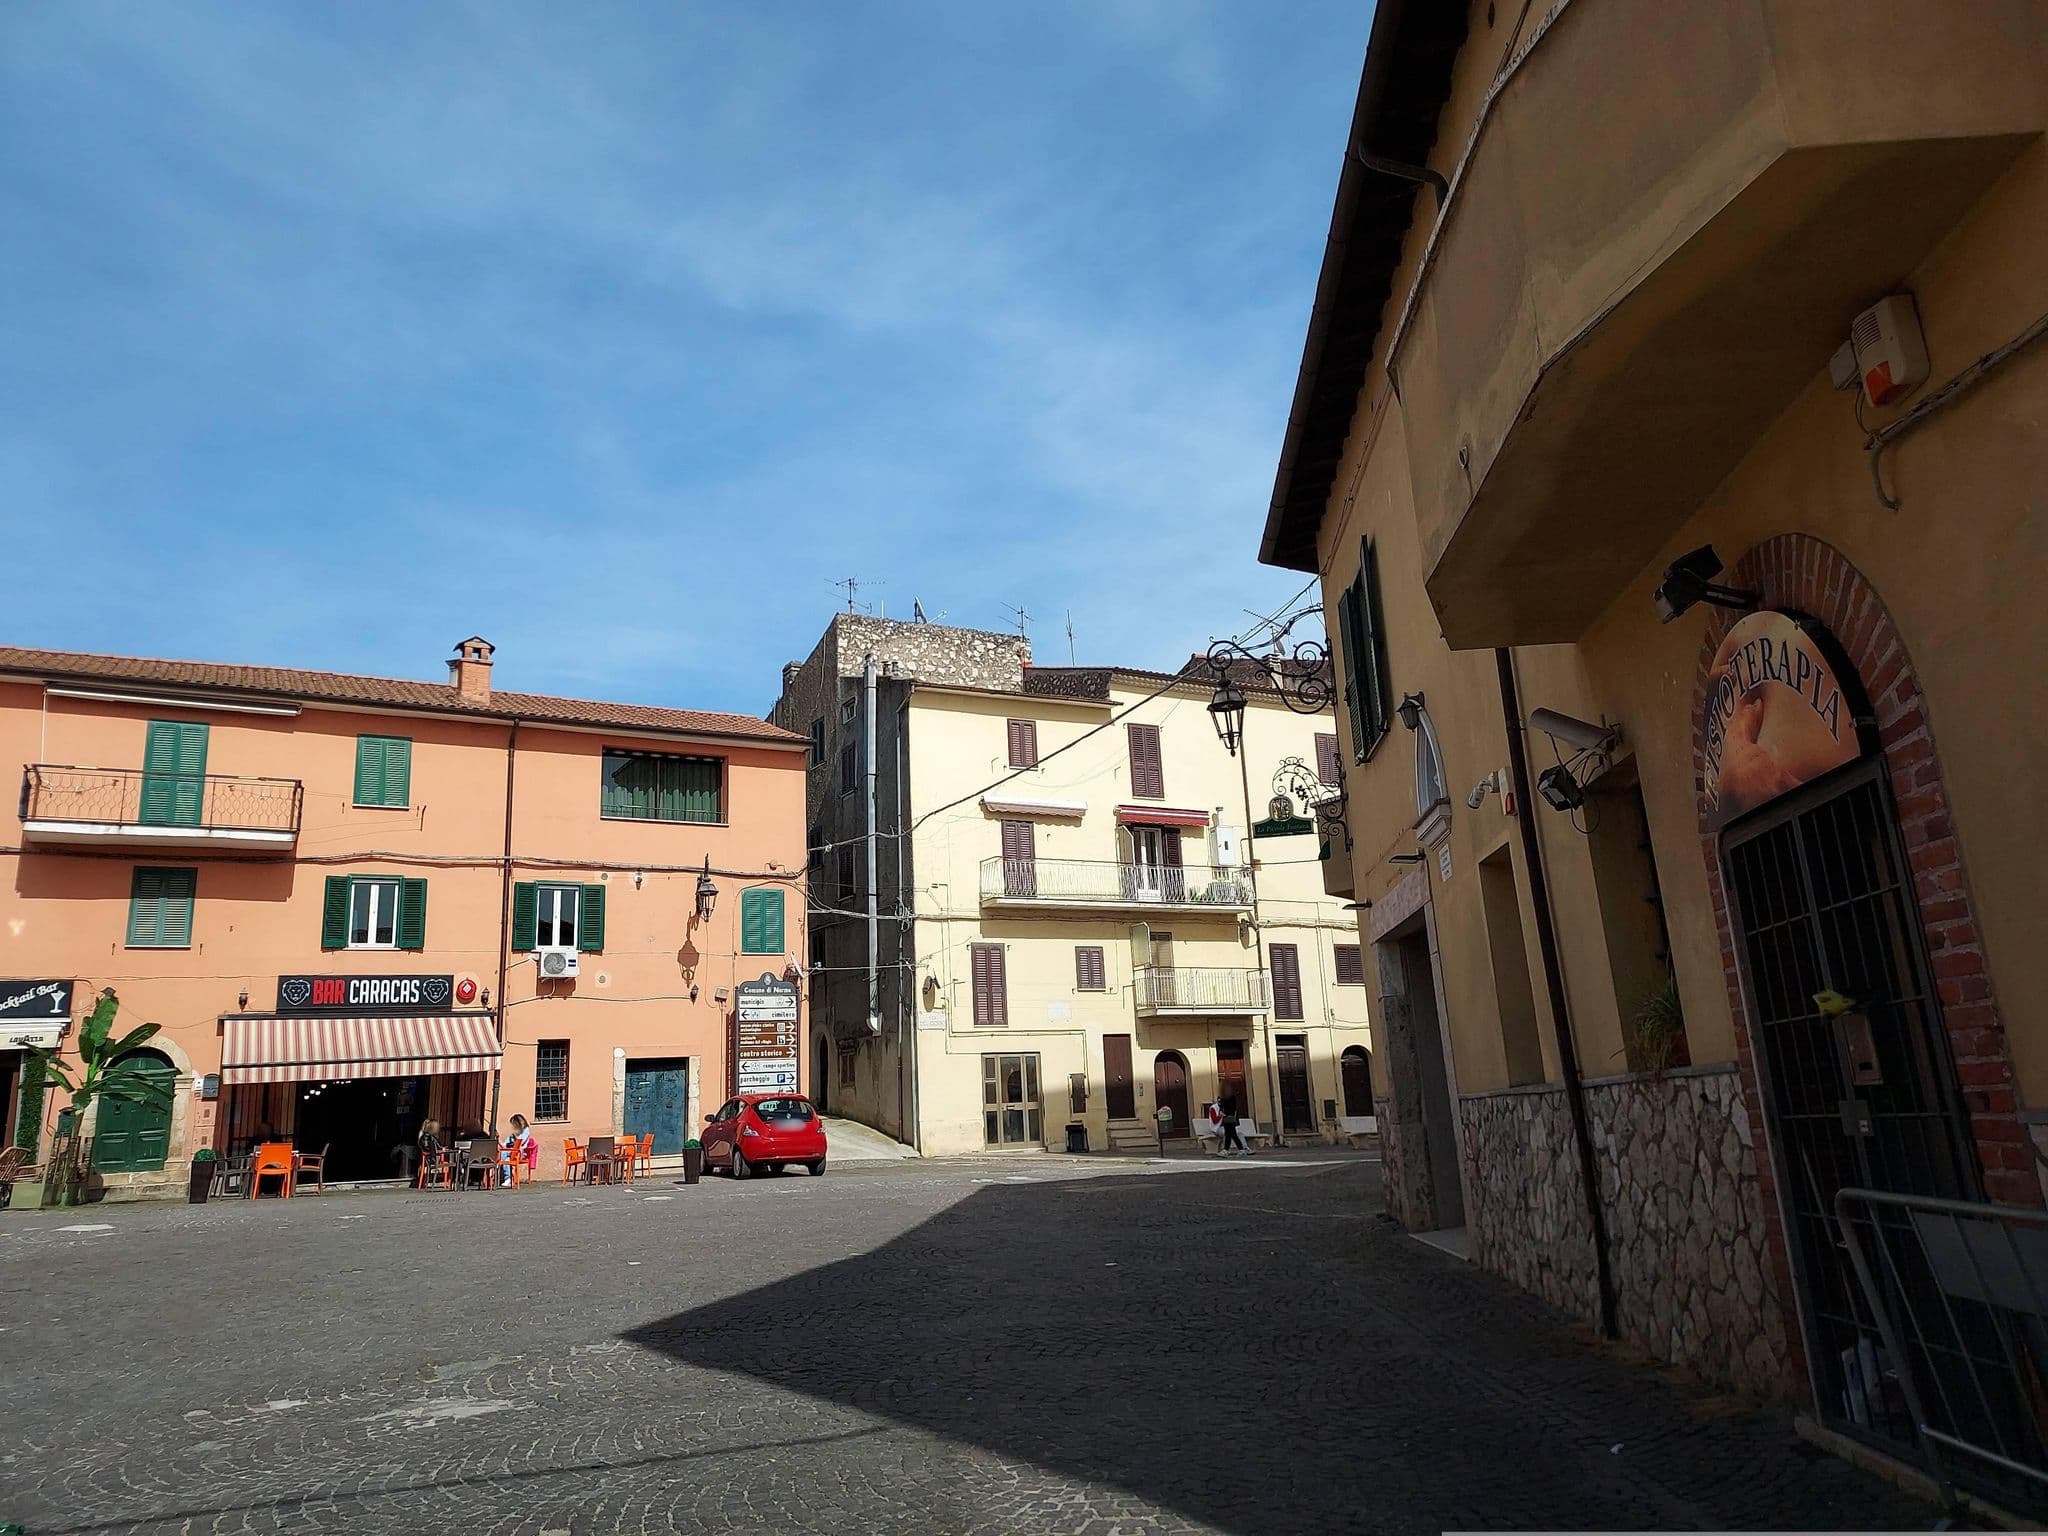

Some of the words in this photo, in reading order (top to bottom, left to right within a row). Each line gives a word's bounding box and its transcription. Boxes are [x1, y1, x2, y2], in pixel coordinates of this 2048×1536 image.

[1704, 636, 1841, 812] FISIOTERAPIA
[36, 982, 60, 996] Bar
[312, 979, 346, 1004] BAR
[349, 979, 421, 1004] CARACAS
[740, 998, 765, 1006] municipio
[761, 1049, 783, 1057] storico
[740, 1074, 770, 1084] parcheggio
